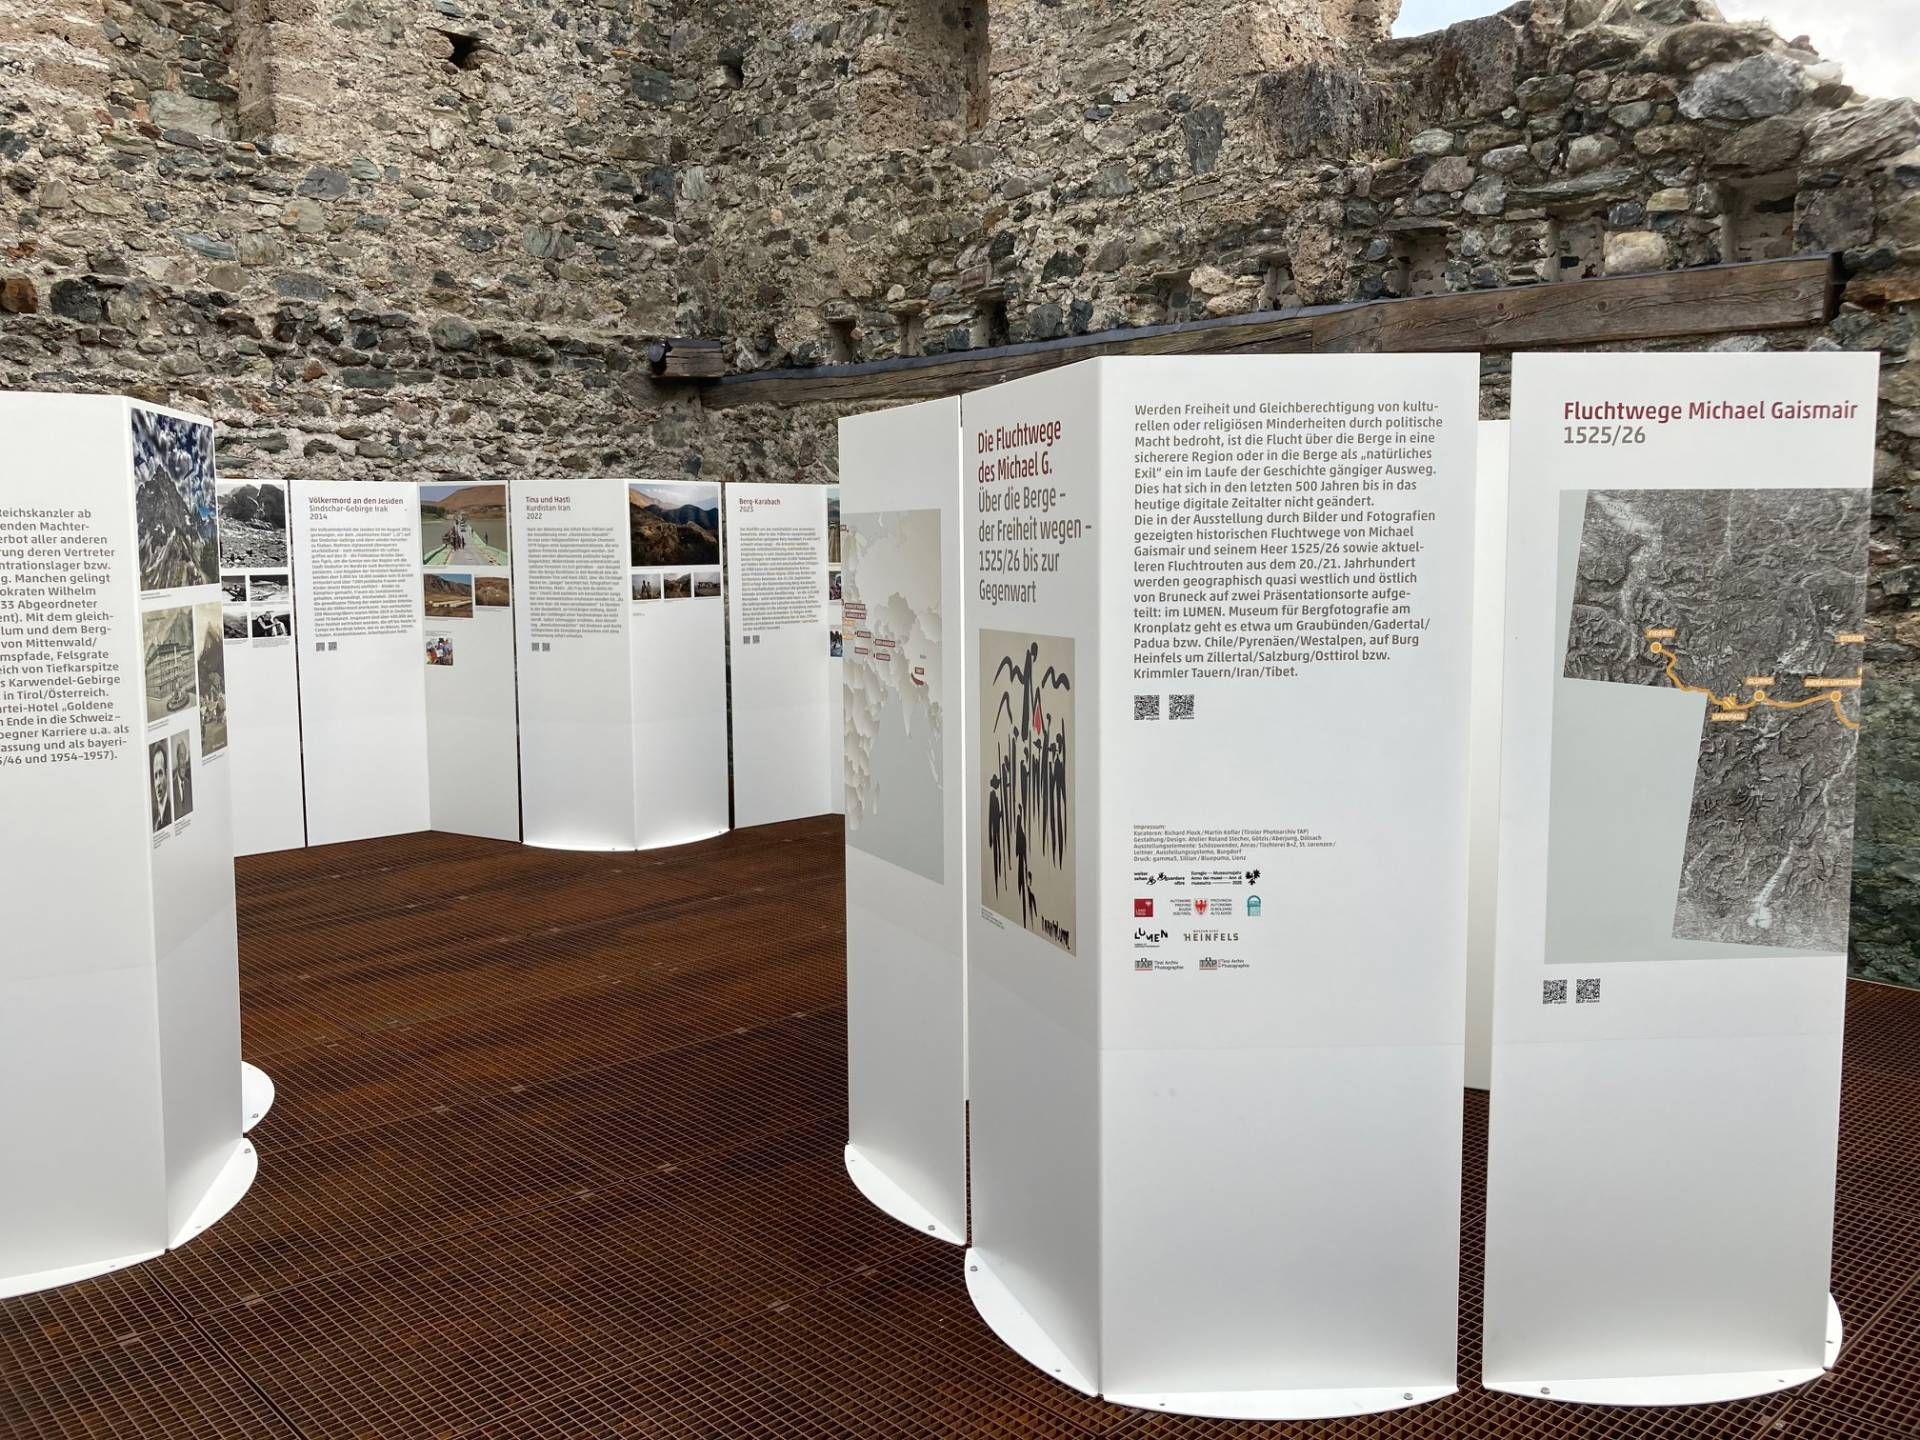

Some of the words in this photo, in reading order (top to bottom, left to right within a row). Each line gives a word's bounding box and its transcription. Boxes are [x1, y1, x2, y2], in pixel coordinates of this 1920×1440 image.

[1135, 403, 1182, 416] Werden
[1185, 403, 1230, 415] Freiheit
[1233, 402, 1256, 414] und
[1259, 401, 1375, 415] Gleichberechtigung
[1377, 403, 1400, 413] von
[1403, 400, 1439, 412] kultu-
[1565, 401, 1682, 424] Fluchtwege
[1689, 401, 1766, 420] Michael
[1771, 400, 1858, 419] Gaismair
[1135, 420, 1170, 432] rellen
[1173, 419, 1202, 431] oder
[1203, 418, 1263, 433] religiösen
[1266, 417, 1346, 430] Minderheiten
[1349, 416, 1383, 429] durch
[1385, 416, 1443, 431] politische
[978, 430, 994, 454] Die
[996, 420, 1061, 451] Fluchtwege
[1135, 435, 1171, 448] Macht
[1173, 434, 1225, 448] bedroht,
[1227, 434, 1242, 446] ist
[1244, 434, 1264, 446] die
[1266, 433, 1303, 446] Flucht
[1305, 432, 1334, 445] über
[1335, 432, 1355, 445] die
[1357, 433, 1392, 447] Berge
[1395, 432, 1407, 444] in
[1409, 431, 1435, 444] eine
[1564, 425, 1646, 446] 1525/26
[1134, 451, 1189, 464] sicherere
[1192, 450, 1234, 465] Region
[1236, 449, 1265, 462] oder
[1267, 449, 1278, 461] in
[1281, 449, 1300, 461] die
[1303, 449, 1338, 463] Berge
[1340, 448, 1358, 461] als
[978, 460, 996, 484] des
[998, 452, 1039, 481] Michael
[1041, 451, 1053, 475] G.
[1165, 466, 1184, 478] ein
[1186, 466, 1202, 478] im
[1205, 466, 1238, 478] Laufe
[1240, 465, 1261, 477] der
[1263, 464, 1327, 477] Geschichte
[1329, 464, 1383, 478] gängiger
[1385, 464, 1437, 477] Ausweg.
[1135, 483, 1160, 495] Dies
[1163, 482, 1183, 494] hat
[1184, 482, 1208, 494] sich
[1210, 482, 1222, 494] in
[1224, 481, 1248, 494] den
[1250, 481, 1293, 493] letzten
[1295, 480, 1318, 492] 500
[1320, 480, 1360, 492] Jahren
[1363, 479, 1380, 491] bis
[1382, 479, 1394, 491] in
[1397, 479, 1417, 491] das
[739, 498, 781, 506] Berg-Karabach
[978, 487, 1002, 513] Über
[1004, 485, 1021, 511] die
[1023, 486, 1057, 513] Berge
[1135, 498, 1181, 512] heutige
[1183, 497, 1229, 512] digitale
[1231, 496, 1283, 509] Zeitalter
[1284, 496, 1315, 508] nicht
[1316, 495, 1375, 510] geändert.
[1135, 514, 1154, 526] Die
[1157, 514, 1168, 526] in
[1170, 513, 1192, 525] der
[1193, 512, 1263, 526] Ausstellung
[1266, 512, 1300, 524] durch
[1302, 511, 1339, 523] Bilder
[1341, 510, 1364, 522] und
[1366, 510, 1436, 524] Fotografien
[40, 521, 90, 532] Machter-
[978, 519, 996, 544] der
[997, 515, 1038, 542] Freiheit
[1040, 518, 1082, 545] wegen
[1134, 529, 1194, 544] gezeigten
[1196, 528, 1268, 540] historischen
[1271, 527, 1341, 541] Fluchtwege
[1343, 528, 1366, 538] von
[1369, 526, 1415, 538] Michael
[1134, 544, 1186, 557] Gaismair
[1188, 544, 1212, 556] und
[1214, 543, 1257, 556] seinem
[1260, 544, 1289, 555] Heer
[1291, 542, 1340, 555] 1525/26
[1342, 541, 1379, 554] sowie
[1381, 541, 1424, 553] aktuel-
[83, 560, 112, 570] bzw.
[979, 548, 1020, 575] 1525/26
[1023, 547, 1039, 572] bis
[1041, 553, 1060, 572] zur
[1134, 561, 1165, 572] leren
[1168, 560, 1244, 572] Fluchtrouten
[1246, 561, 1267, 571] aus
[1269, 558, 1296, 570] dem
[1300, 558, 1341, 571] 20./21.
[1344, 556, 1416, 569] Jahrhundert
[15, 573, 67, 583] Manchen
[69, 573, 111, 585] gelingt
[48, 586, 97, 596] Wilhelm
[979, 578, 1037, 606] Gegenwart
[18, 599, 98, 611] Abgeordneter
[27, 625, 50, 635] und
[52, 625, 78, 635] dem
[81, 625, 111, 636] Berg-
[0, 641, 23, 649] von
[25, 637, 98, 649] Mittenwald/
[57, 650, 109, 662] Felsgrate
[8, 674, 121, 690] Karwendel-Gebirge
[1134, 928, 1168, 942] LUMEN
[1184, 933, 1239, 942] HEINFELS
